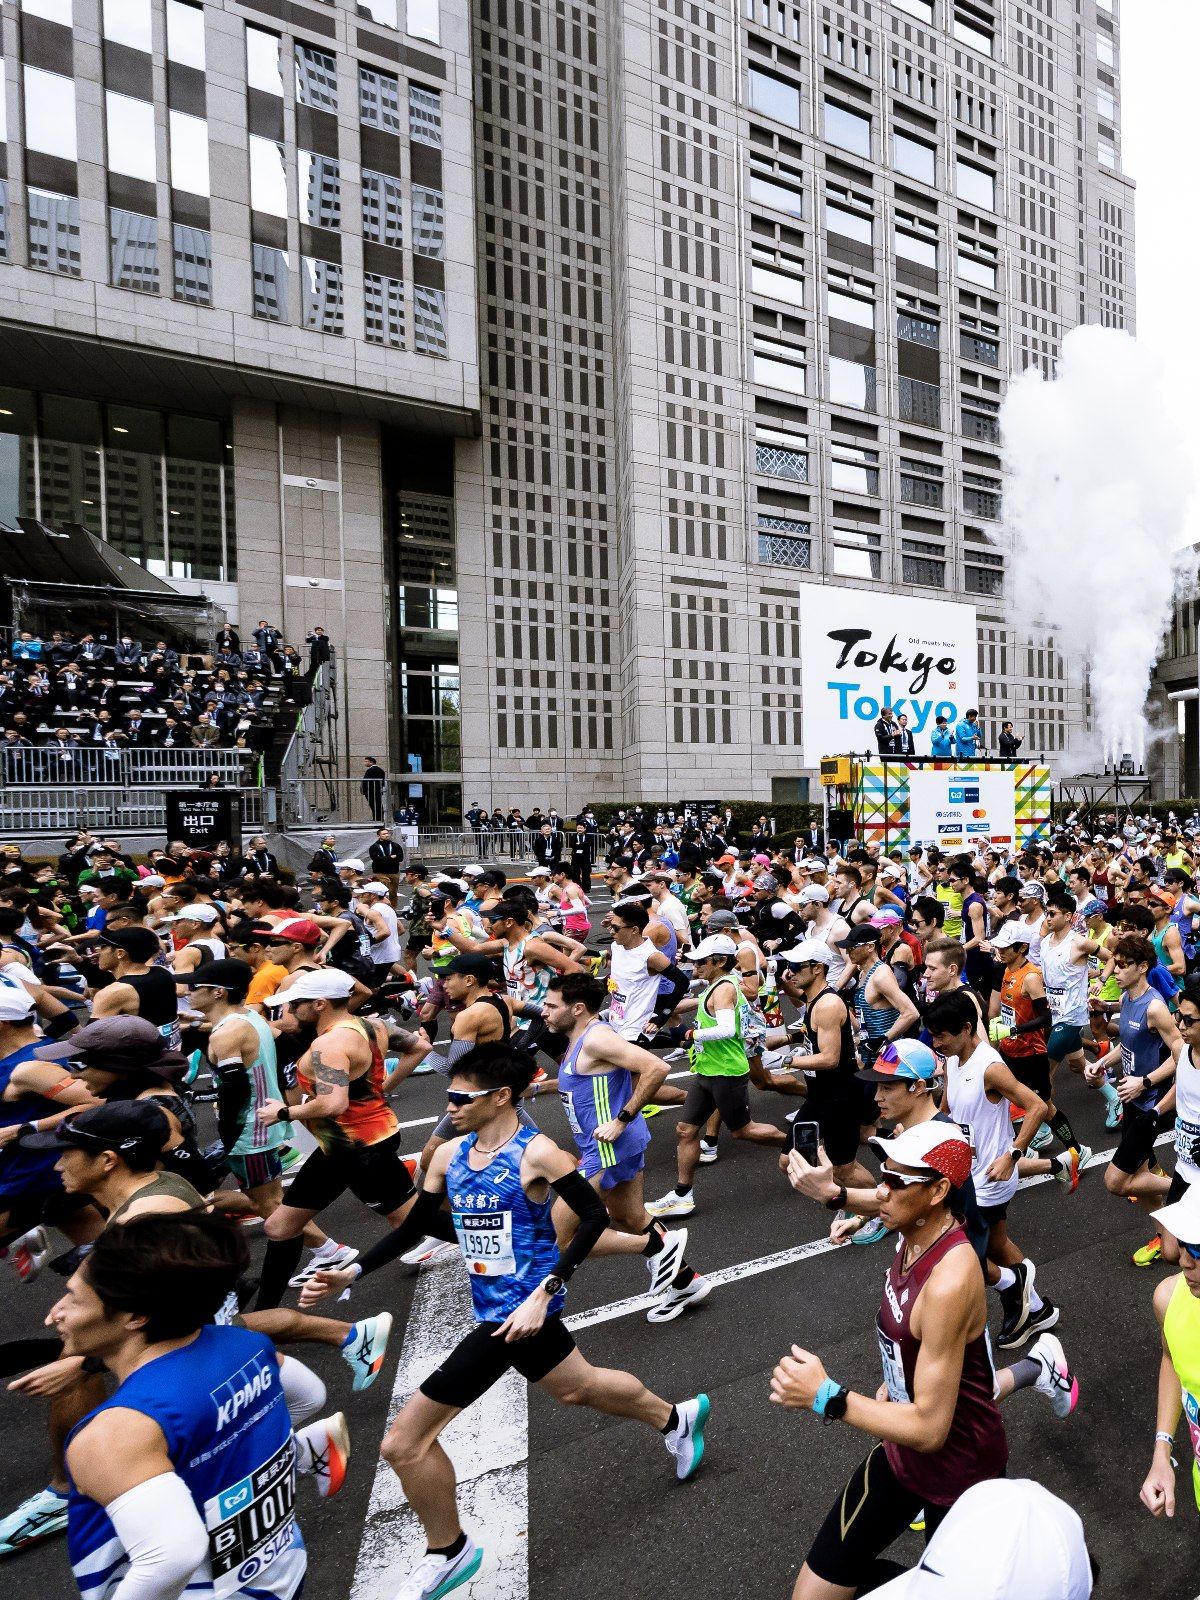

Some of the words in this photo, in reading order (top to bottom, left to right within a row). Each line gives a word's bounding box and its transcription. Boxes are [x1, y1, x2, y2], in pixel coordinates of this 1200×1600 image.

[827, 629, 956, 694] Tokyo
[827, 682, 957, 734] Tokyo
[184, 816, 214, 826] 出口
[453, 1194, 499, 1209] 東京都庁
[464, 1218, 500, 1227] 東京メトロ
[464, 1234, 500, 1255] 19925
[216, 1365, 272, 1432] KPMG
[215, 1528, 236, 1553] B
[222, 1557, 231, 1570] 1
